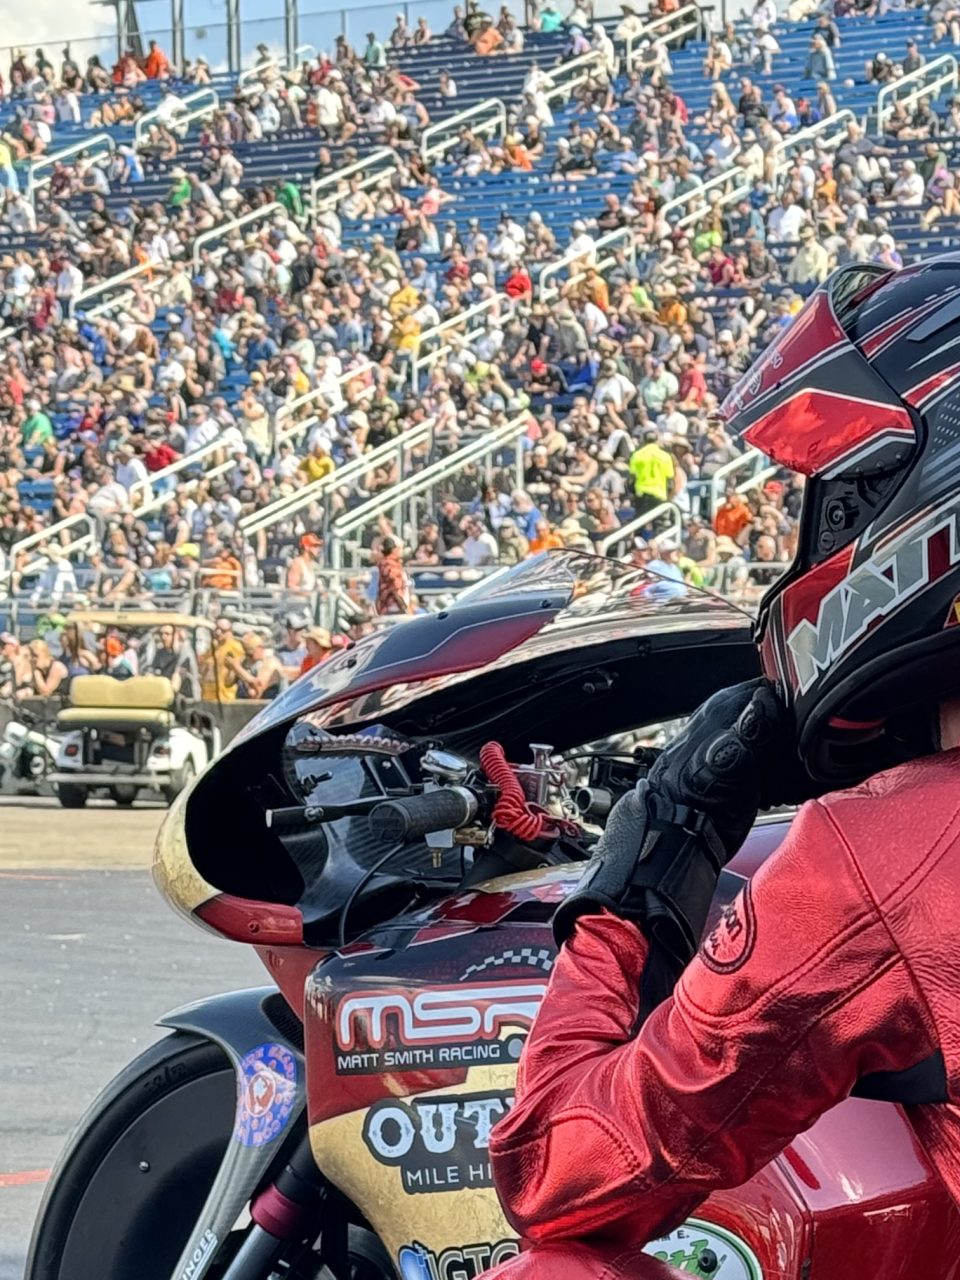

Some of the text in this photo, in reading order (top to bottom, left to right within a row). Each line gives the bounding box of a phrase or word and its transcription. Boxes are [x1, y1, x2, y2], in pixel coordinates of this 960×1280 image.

[338, 1044, 500, 1070] MATT SMITH RACING
[368, 1097, 515, 1159] OUT
[407, 1166, 459, 1187] MILE
